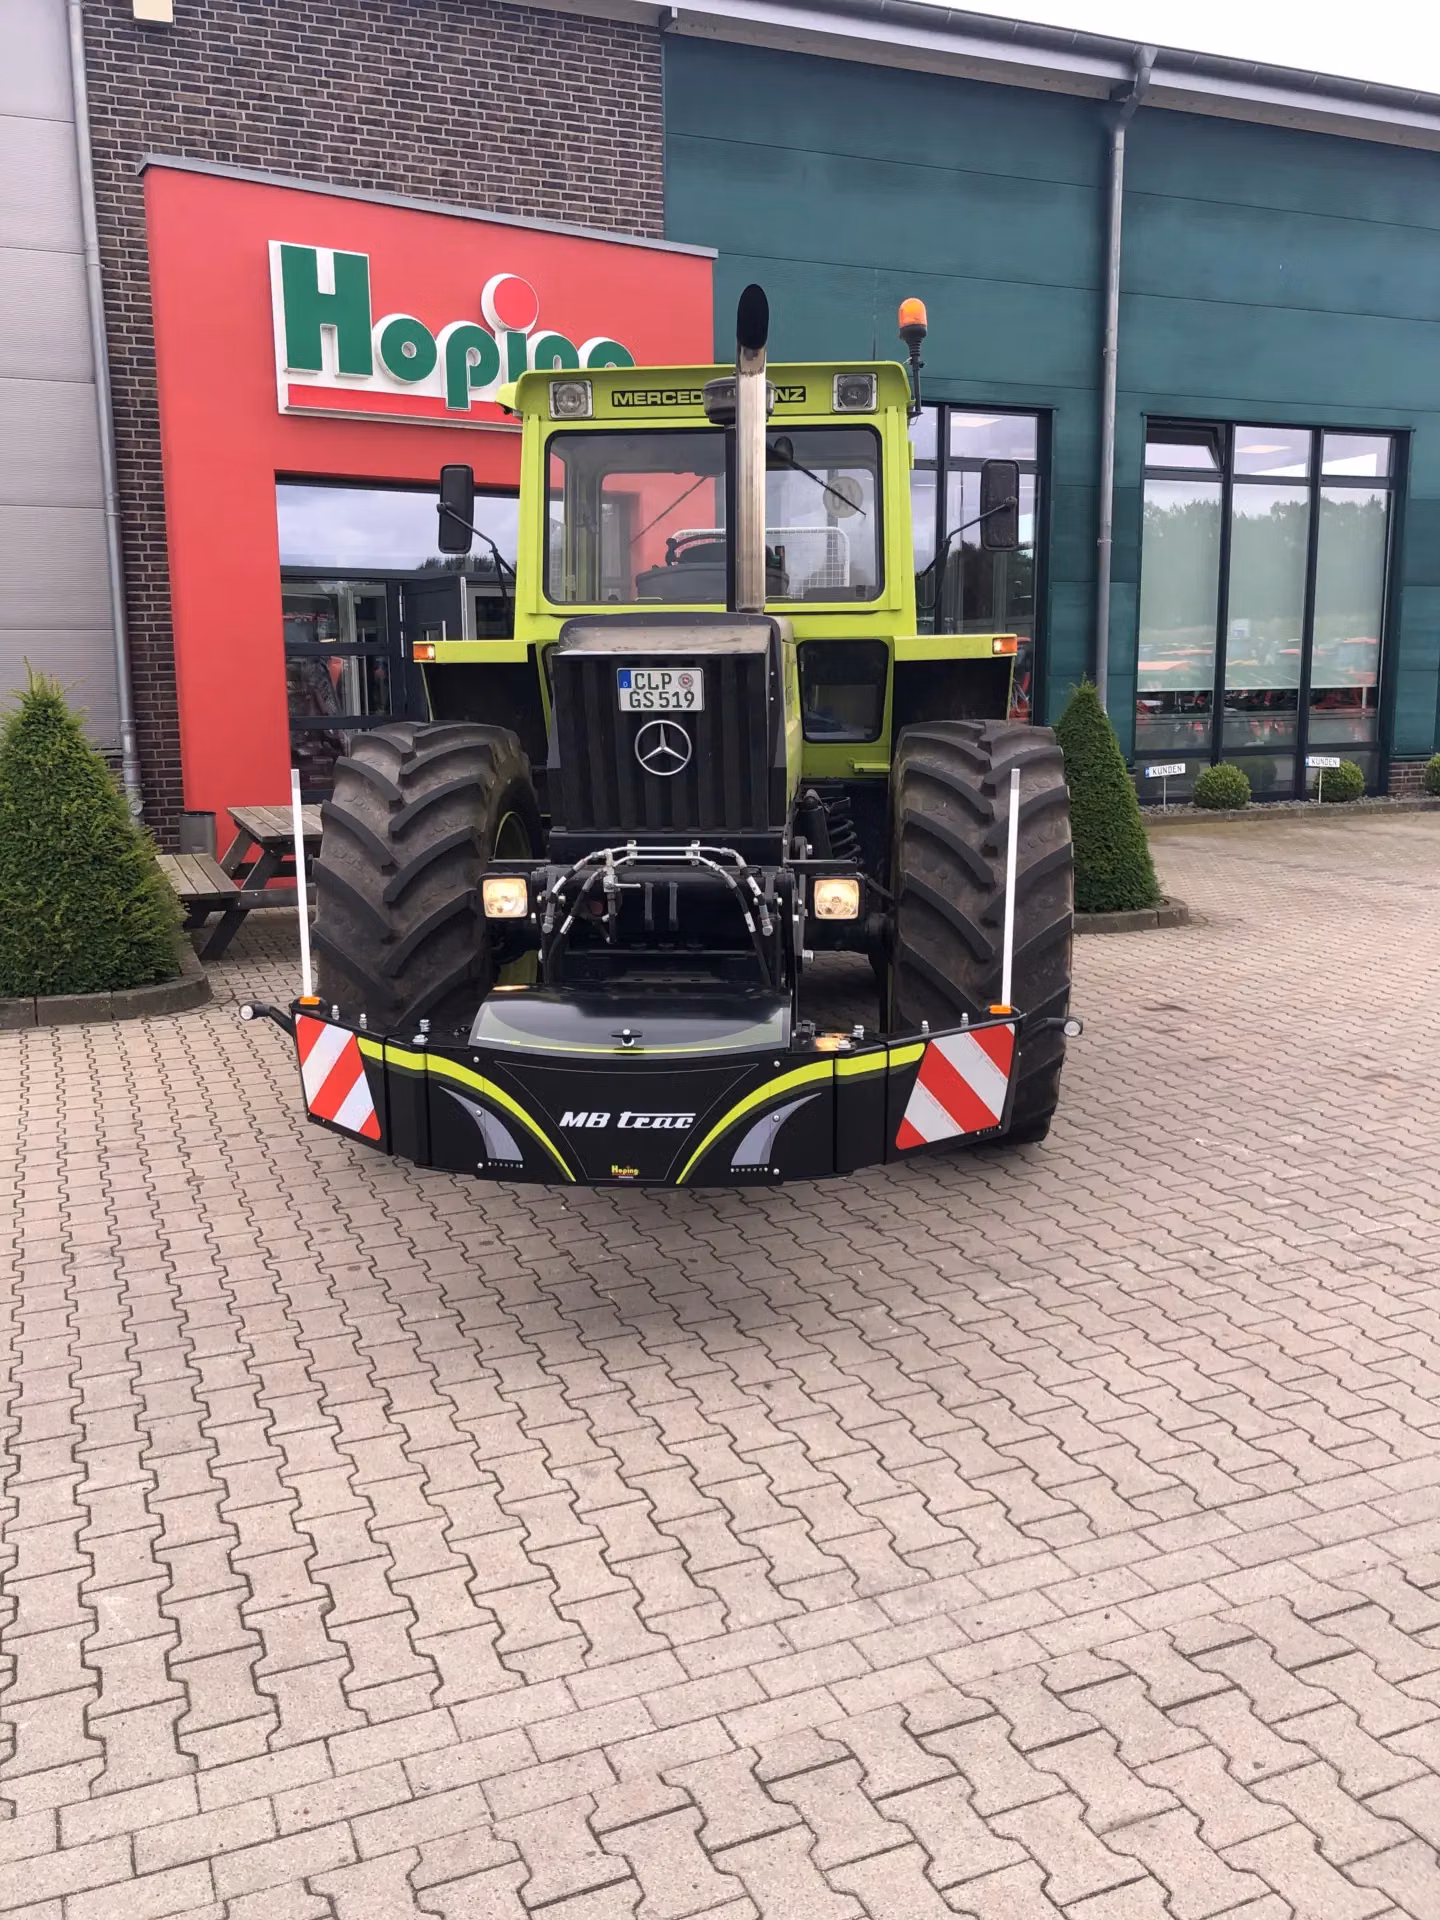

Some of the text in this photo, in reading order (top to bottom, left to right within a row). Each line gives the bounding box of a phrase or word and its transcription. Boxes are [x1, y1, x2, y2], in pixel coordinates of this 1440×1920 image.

[276, 242, 636, 411] Hopin
[613, 387, 805, 406] MERCED NZ
[634, 672, 672, 690] CLP
[1152, 764, 1183, 775] KUNDEN
[1311, 757, 1338, 767] KUNDEN
[559, 1111, 696, 1129] MB trac
